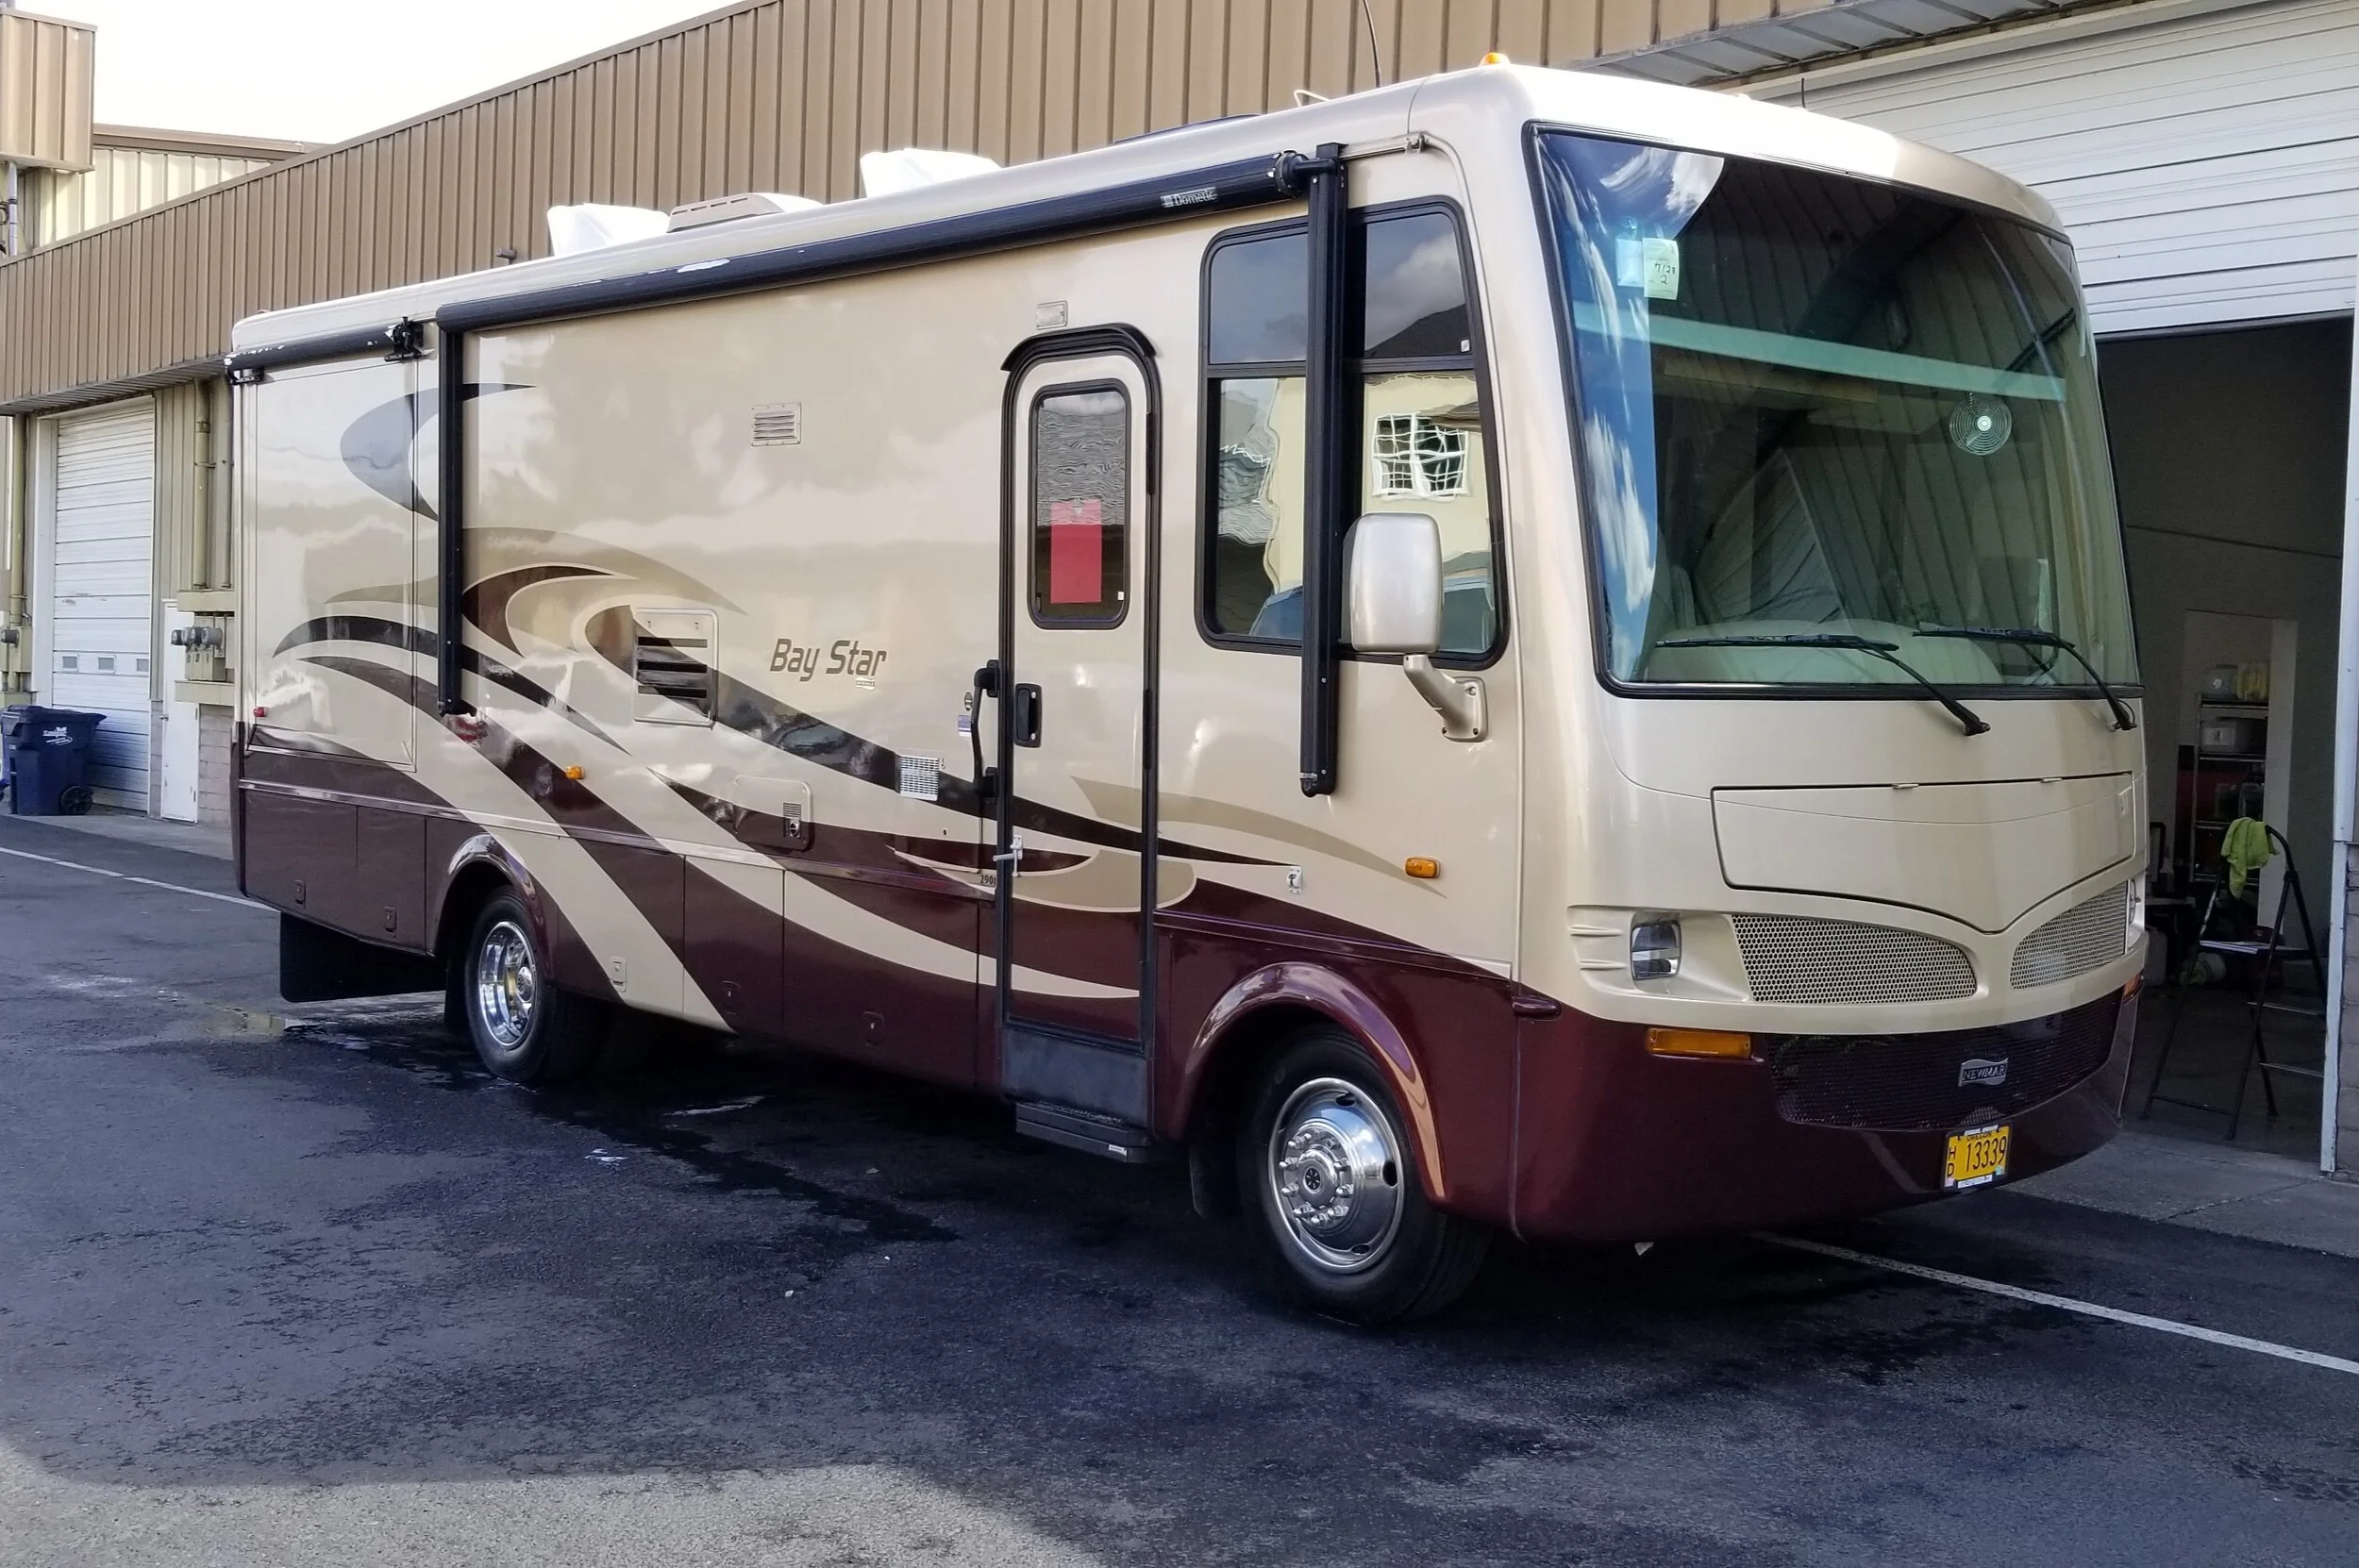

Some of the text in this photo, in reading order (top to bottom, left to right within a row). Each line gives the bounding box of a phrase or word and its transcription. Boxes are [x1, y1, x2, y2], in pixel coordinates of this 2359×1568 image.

[769, 638, 887, 682] Bay Star
[1962, 1064, 2006, 1081] NEWMAR
[1966, 1135, 2007, 1173] 13339
